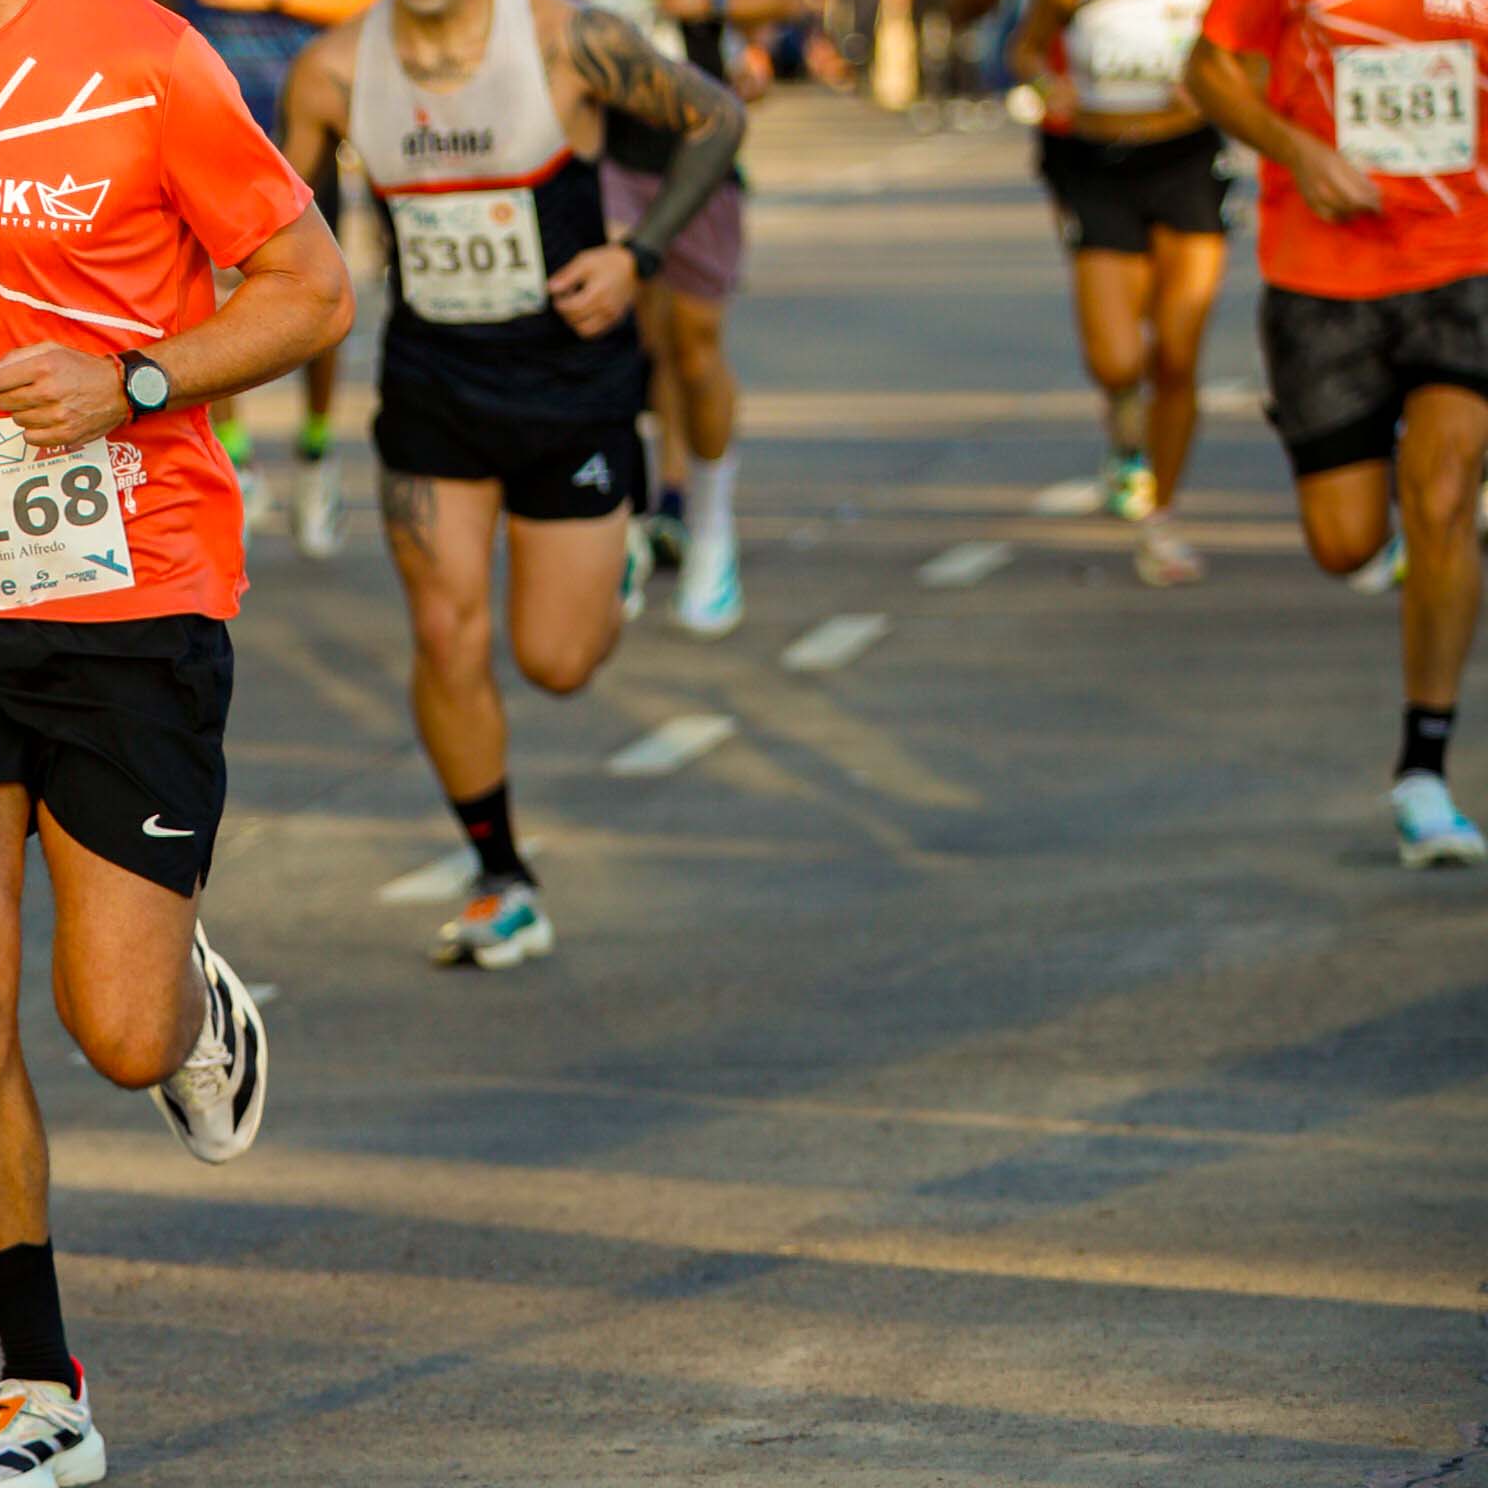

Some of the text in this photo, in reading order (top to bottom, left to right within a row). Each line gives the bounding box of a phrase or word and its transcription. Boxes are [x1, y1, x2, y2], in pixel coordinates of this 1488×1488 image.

[37, 219, 93, 232] NORTE
[405, 234, 528, 275] 5301
[19, 540, 66, 557] Alfredo
